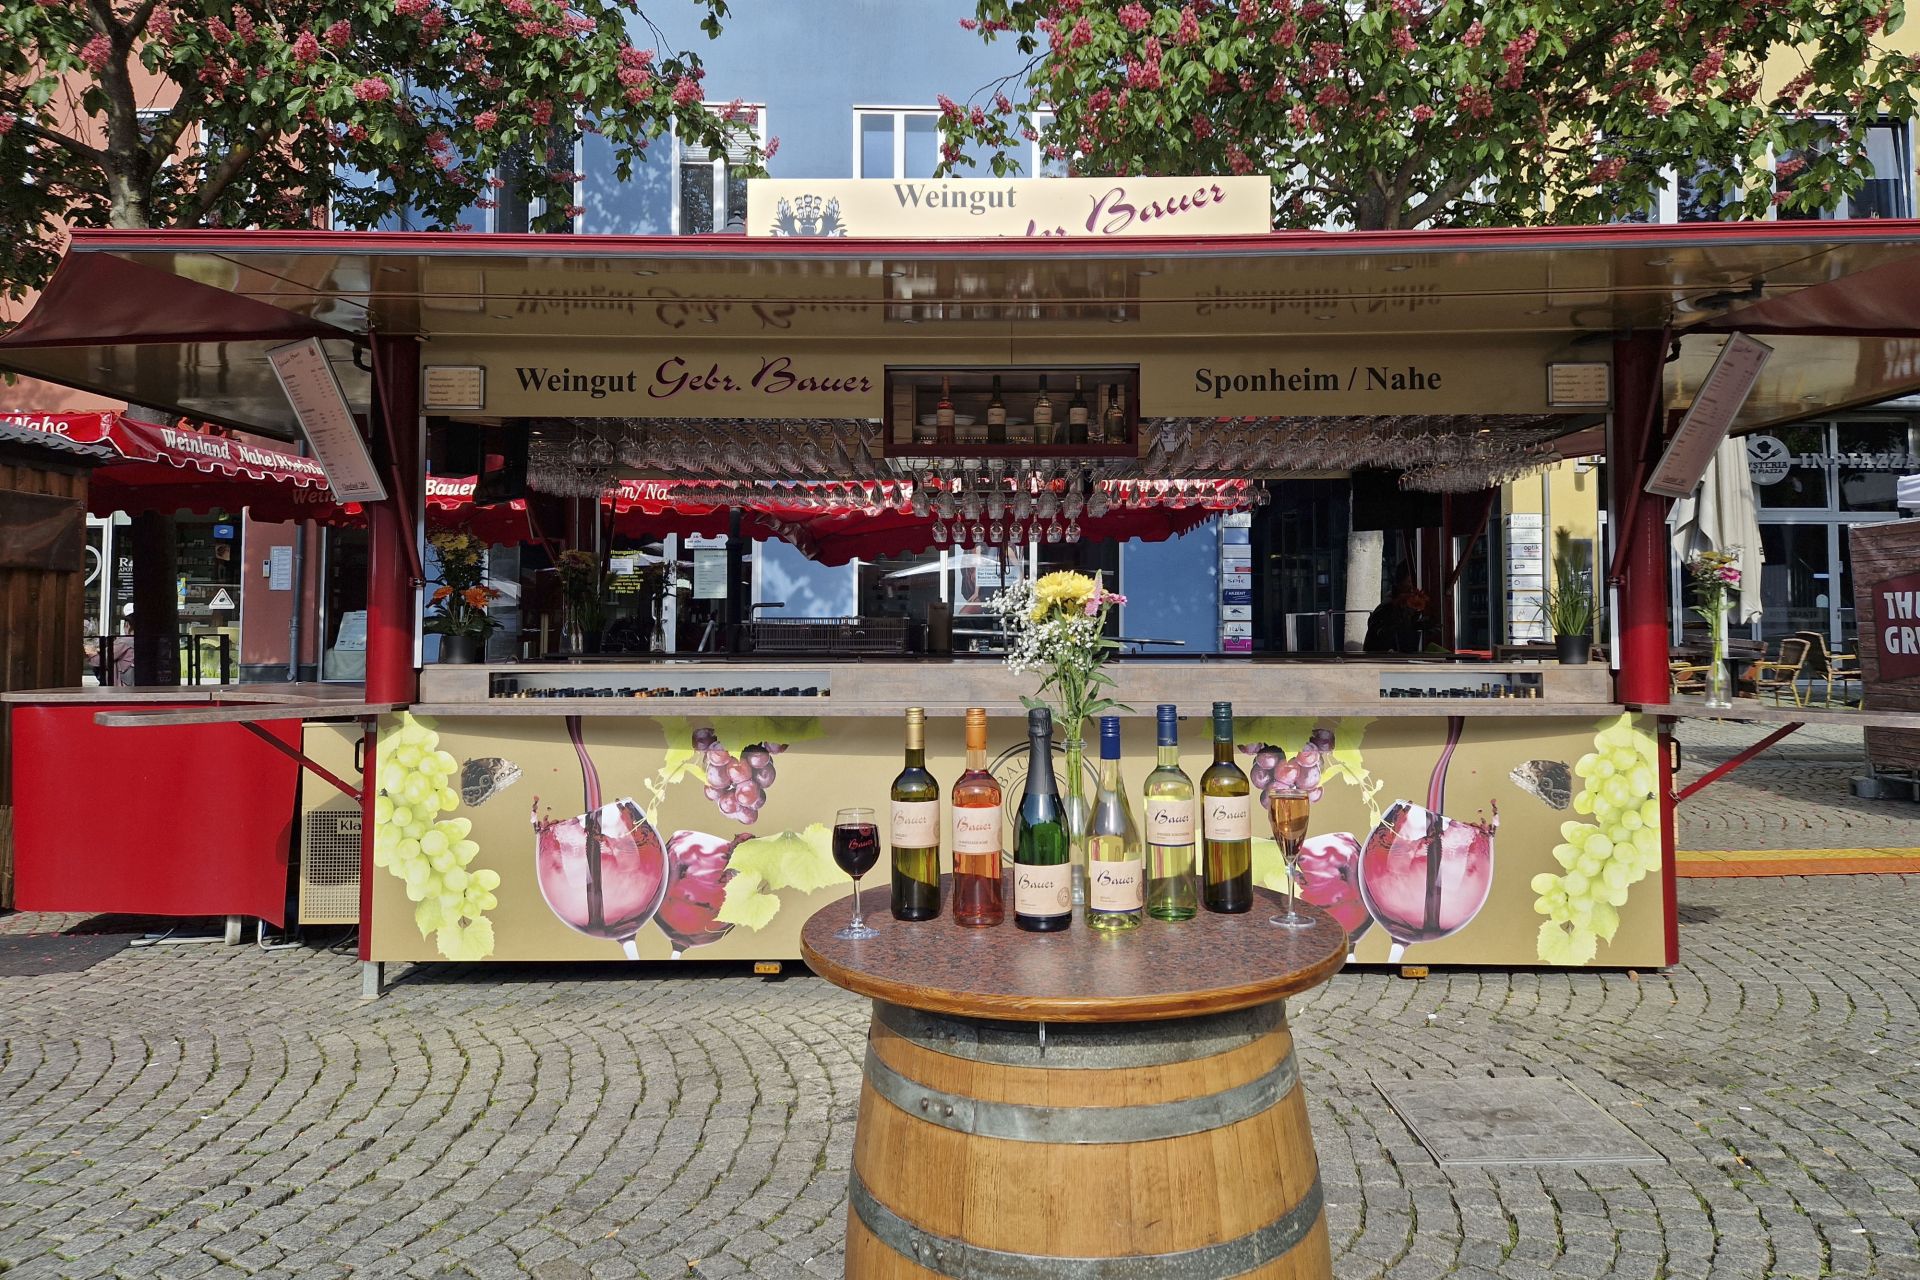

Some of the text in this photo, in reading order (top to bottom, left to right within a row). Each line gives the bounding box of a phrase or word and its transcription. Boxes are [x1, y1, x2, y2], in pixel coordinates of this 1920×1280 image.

[893, 183, 1016, 215] Weingut
[1085, 182, 1227, 234] Bauer
[515, 367, 637, 399] Weingut
[648, 356, 742, 398] Gebr.
[751, 356, 874, 393] Bauer
[1195, 366, 1442, 399] Sponheim / Nahe
[161, 428, 231, 460] Weinland
[1800, 452, 1829, 469] IN
[426, 479, 477, 496] Bauer
[1885, 626, 1920, 654] GR
[893, 810, 926, 825] Bauer
[1154, 809, 1189, 824] Bauer
[1212, 805, 1247, 820] Bauer
[956, 816, 992, 832] Bauer
[1018, 873, 1054, 889] Bauer
[1097, 870, 1134, 886] Bauer
